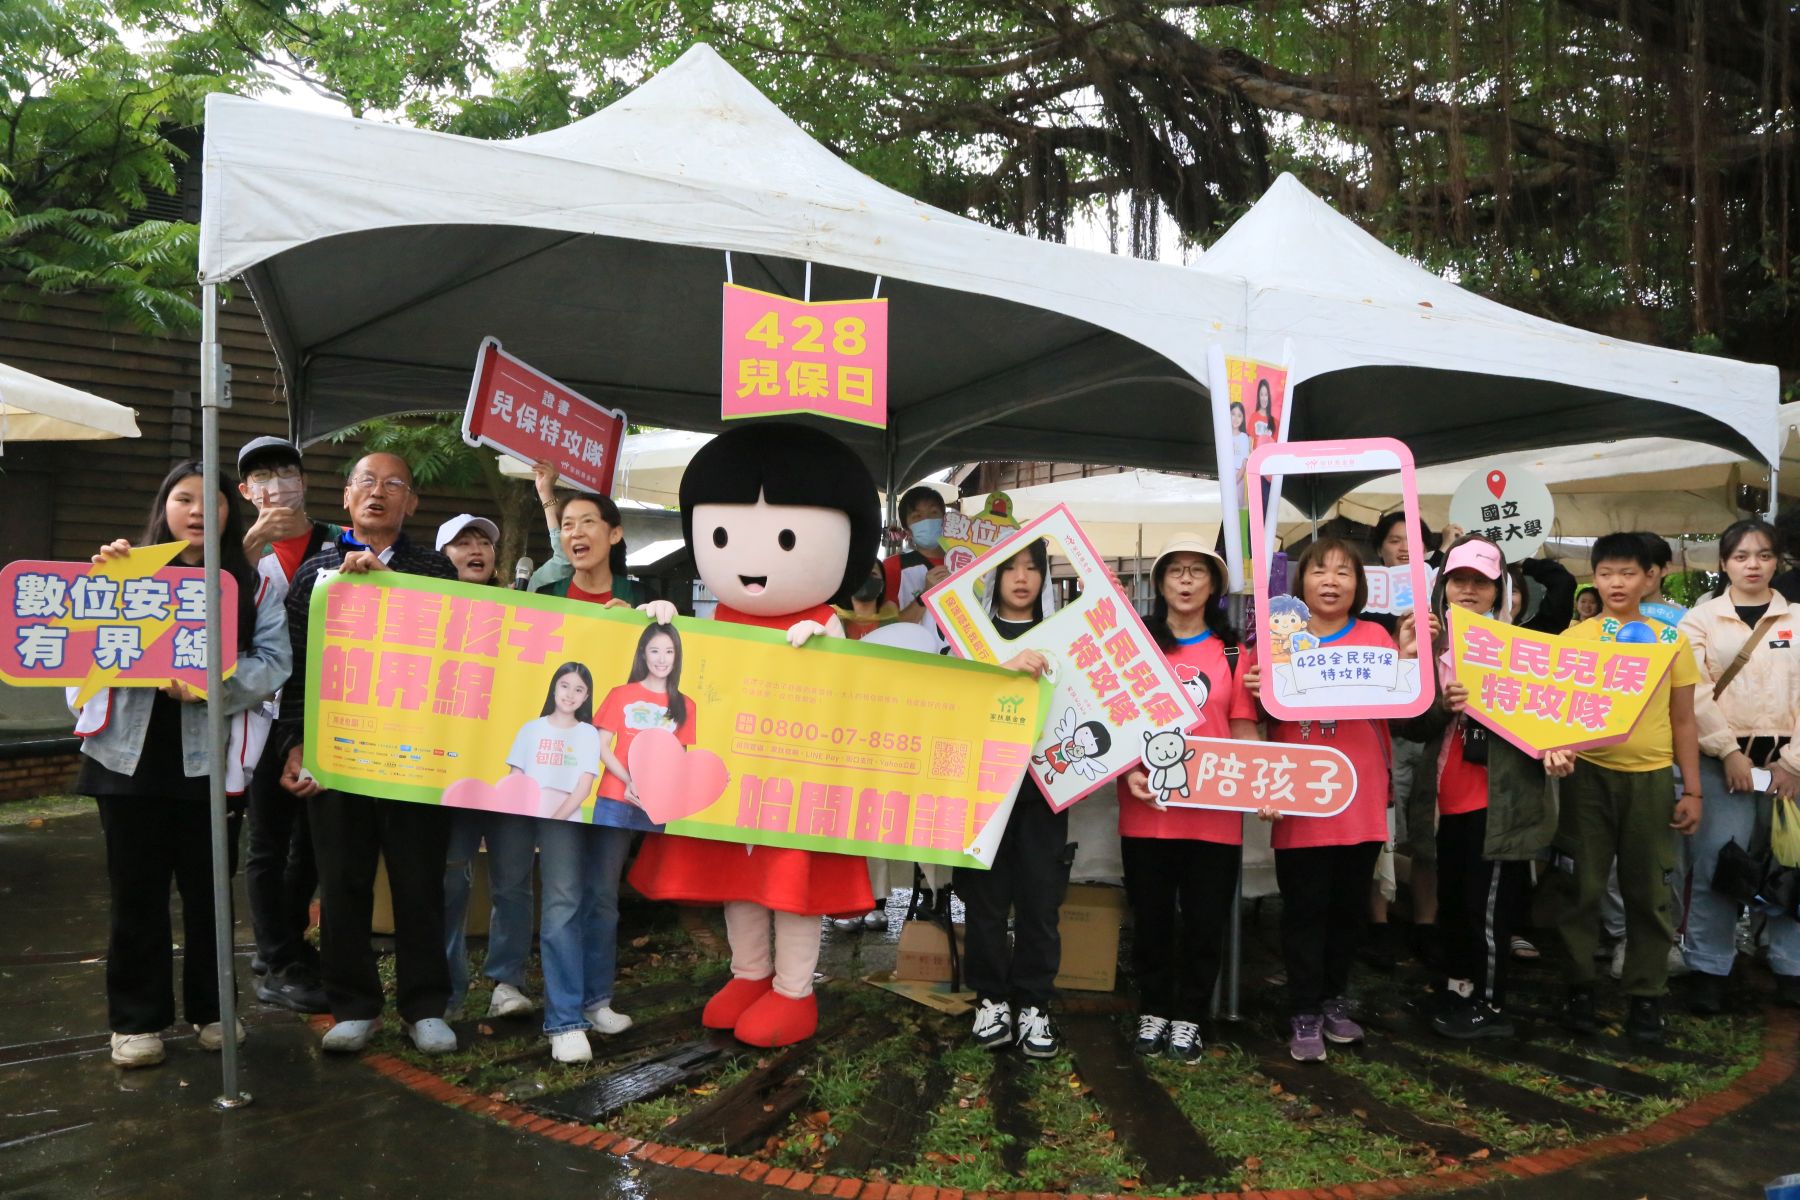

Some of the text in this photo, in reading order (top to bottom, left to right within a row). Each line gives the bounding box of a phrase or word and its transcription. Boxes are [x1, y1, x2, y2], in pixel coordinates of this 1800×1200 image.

[745, 312, 867, 356] 428
[736, 358, 873, 407] 兒保日
[490, 390, 604, 469] 兒保特攻隊
[1466, 519, 1543, 542] 華大學
[1481, 502, 1521, 522] 國立
[15, 574, 207, 620] 數位安全
[325, 582, 565, 665] 尊重孩子
[319, 645, 495, 720] 的界線
[1068, 633, 1140, 726] 特攻隊
[1084, 596, 1184, 727] 全民兒保
[1297, 652, 1393, 668] 428全民兒保
[1321, 668, 1371, 681] 特攻隊
[1463, 625, 1650, 694] 全民兒保
[1481, 673, 1612, 731] 特攻隊
[760, 717, 922, 753] 0800-07-8585
[1195, 752, 1342, 804] 陪孩子
